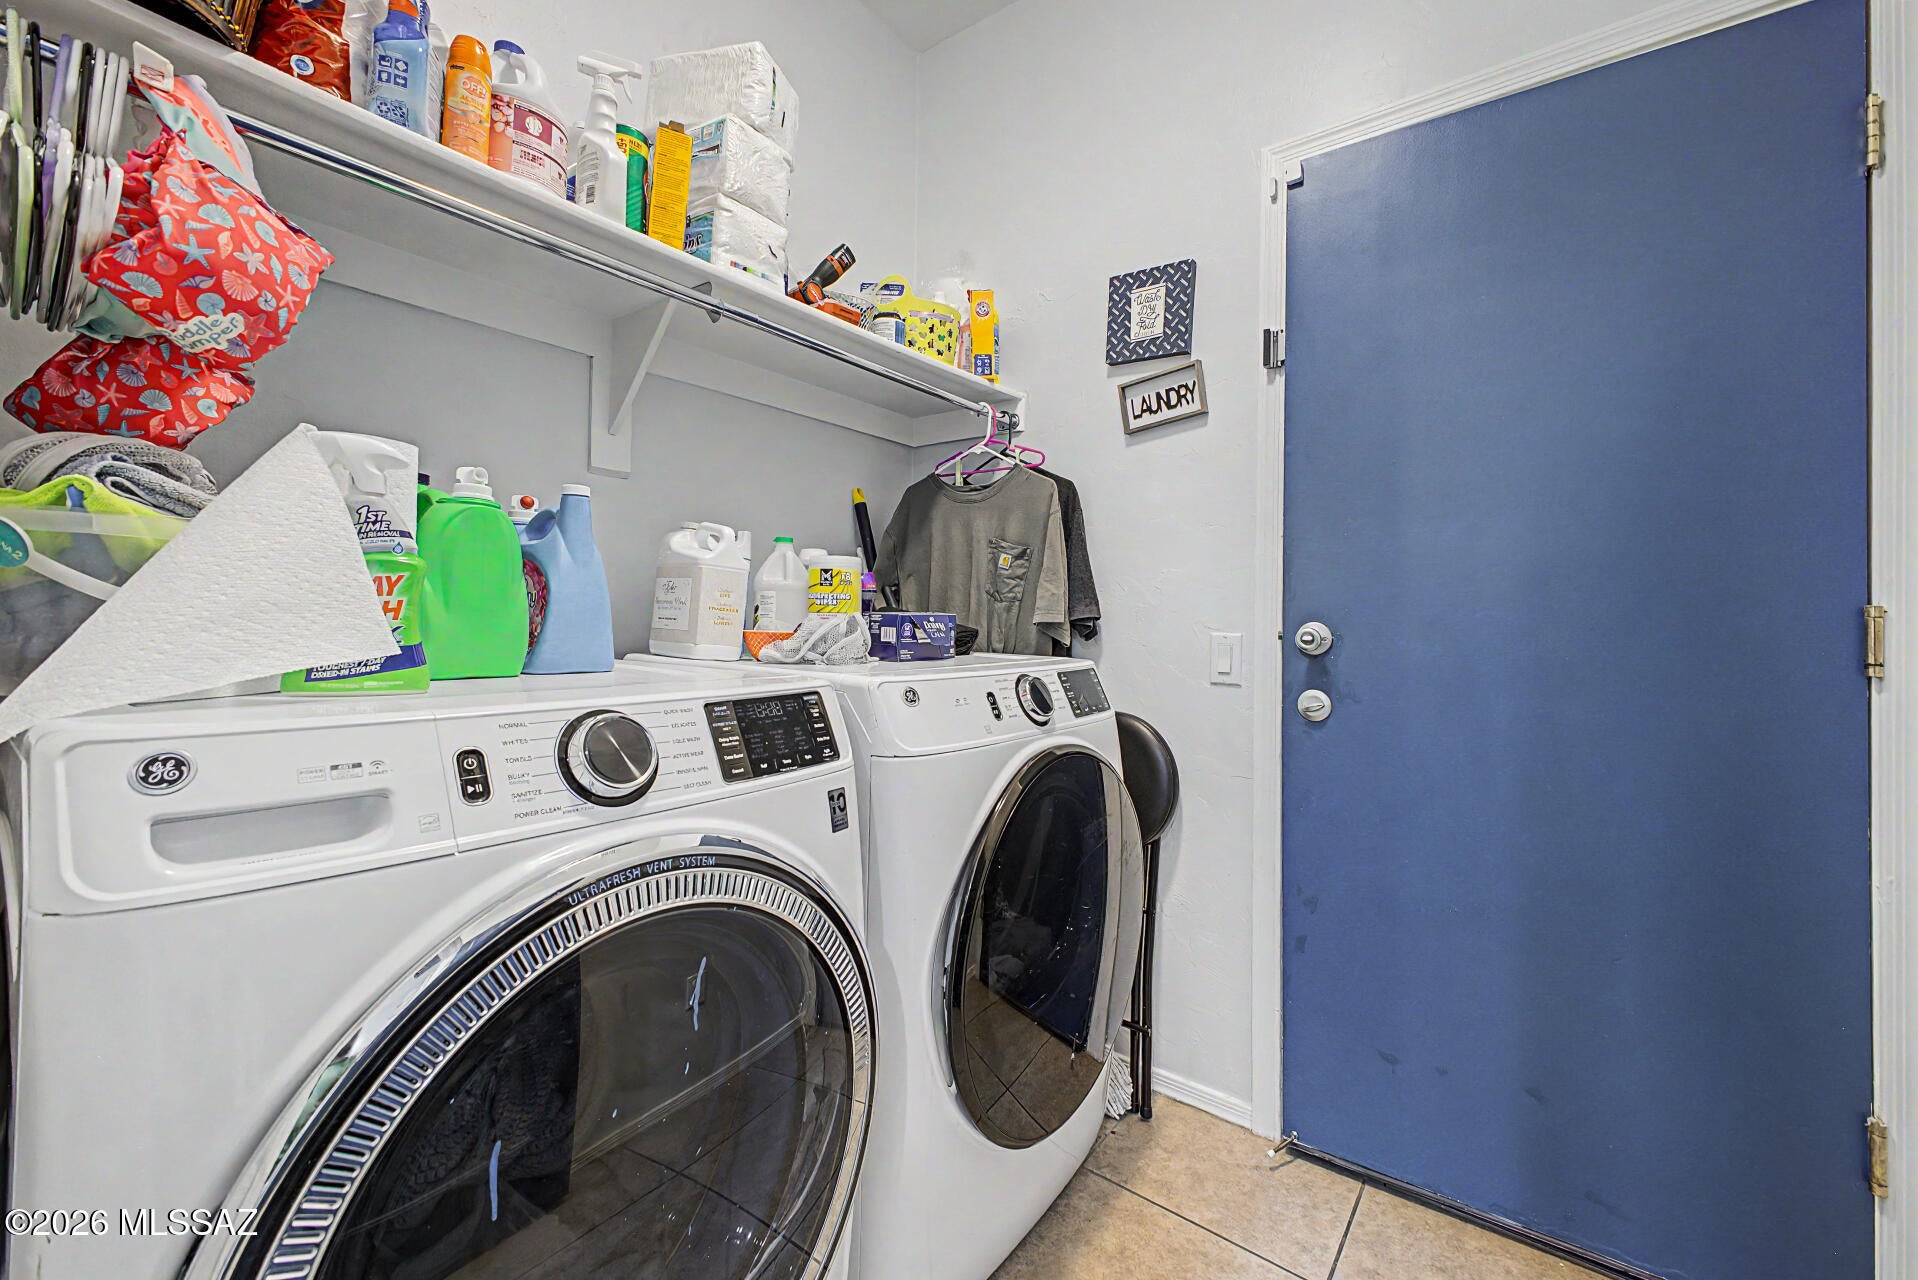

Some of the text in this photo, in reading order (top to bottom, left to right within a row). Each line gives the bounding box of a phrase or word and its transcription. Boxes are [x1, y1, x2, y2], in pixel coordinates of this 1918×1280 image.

[461, 78, 488, 97] OFF!
[1130, 379, 1197, 421] LAUNDRY
[367, 530, 401, 538] REMOVAL
[501, 738, 529, 746] WHITES
[504, 755, 533, 763] TOWELS
[507, 772, 530, 780] BULKY
[511, 789, 542, 799] SANITIZE
[514, 809, 539, 819] POWER
[540, 805, 562, 815] CLEAN
[567, 855, 716, 906] ULTRAFRESH VENT SYSTEM
